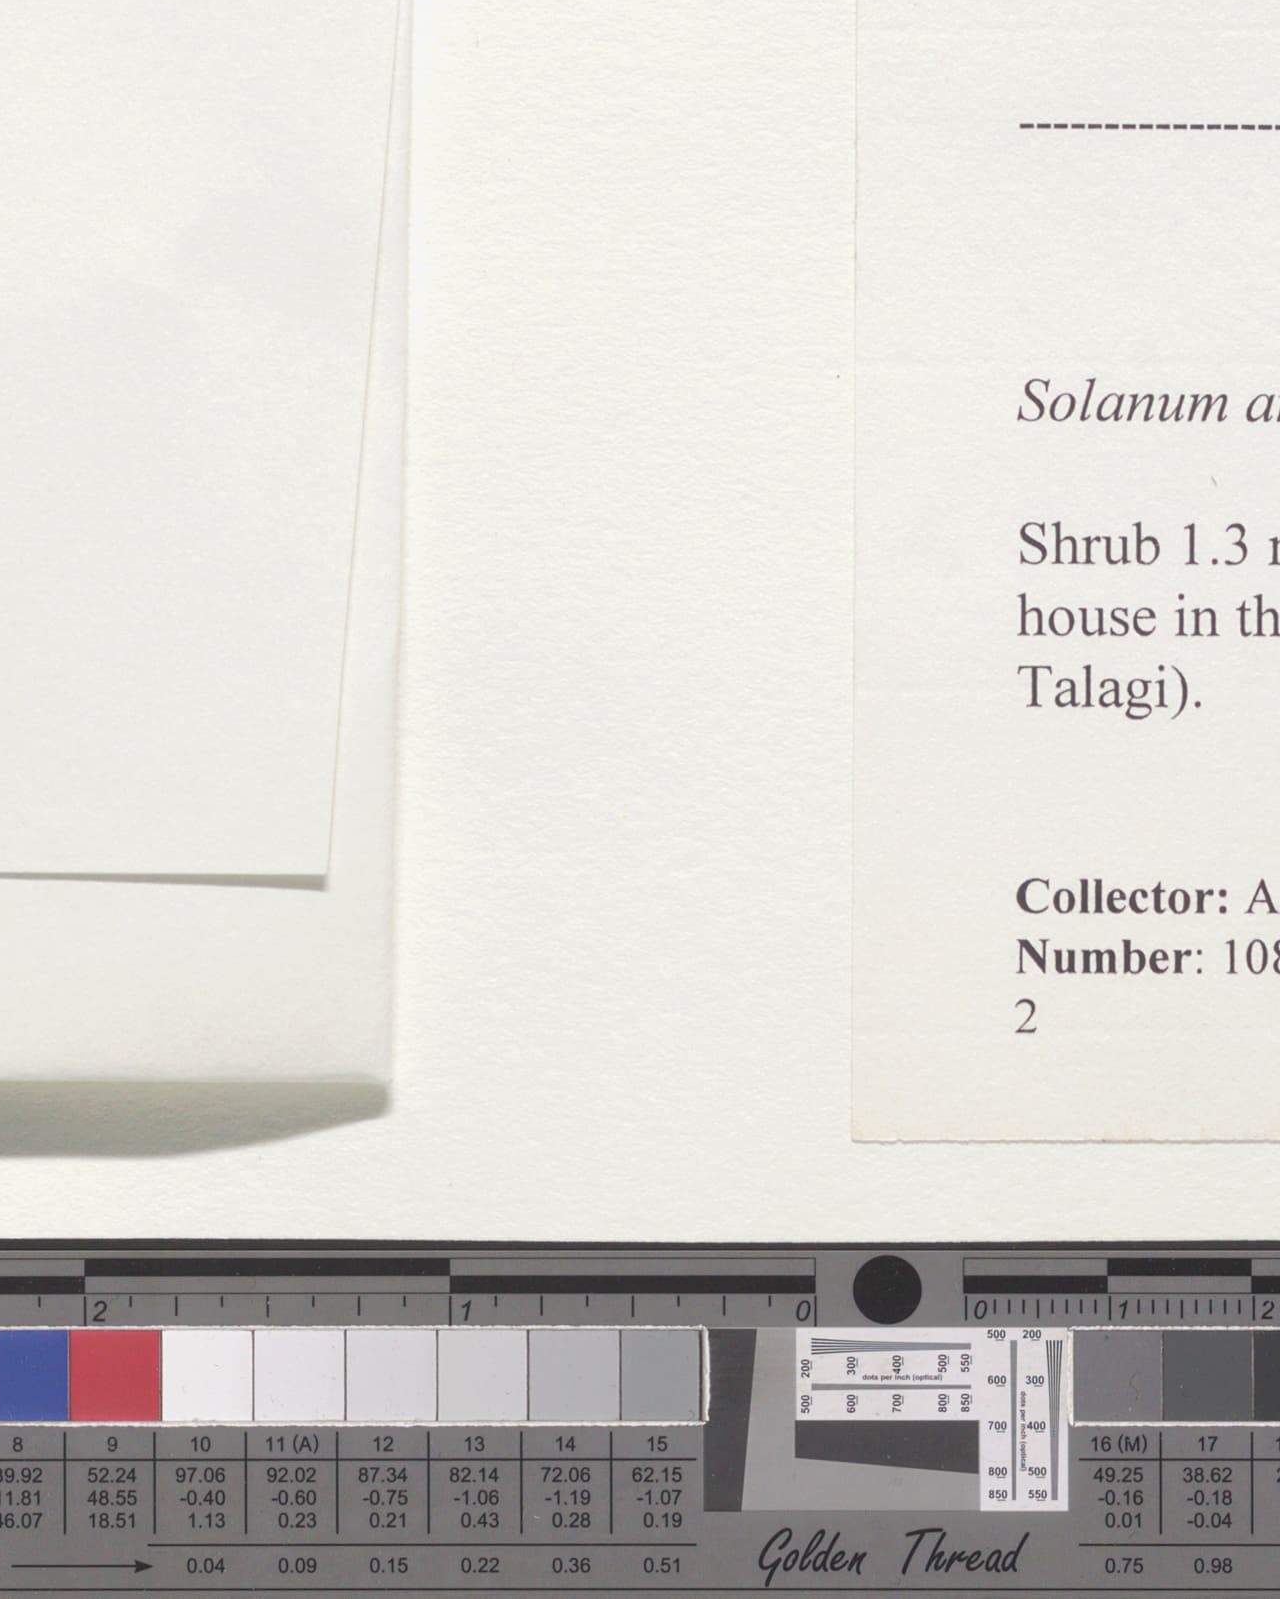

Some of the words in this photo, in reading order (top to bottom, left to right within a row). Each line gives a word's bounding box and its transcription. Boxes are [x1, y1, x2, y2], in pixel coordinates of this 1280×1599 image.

[1016, 377, 1228, 423] Solanum
[1019, 520, 1161, 566] Shrub
[1183, 522, 1248, 566] 1.3
[1017, 592, 1157, 637] house
[1175, 593, 1220, 637] in
[1017, 664, 1202, 721] Talagi).
[1015, 877, 1227, 915] Collector:
[1016, 938, 1203, 975] Number:
[1015, 998, 1037, 1034] 2
[92, 1299, 108, 1323] 2
[461, 1299, 472, 1322] 1
[795, 1299, 812, 1322] 0
[973, 1299, 988, 1320] 0
[1118, 1299, 1129, 1320] 1
[1261, 1300, 1275, 1320] 2
[881, 1374, 893, 1383] per
[894, 1373, 912, 1381] inch
[912, 1373, 943, 1383] (optical)
[12, 1436, 24, 1453] 8
[107, 1436, 118, 1453] 9
[190, 1435, 212, 1453] 10
[265, 1436, 284, 1453] 11
[292, 1433, 320, 1455] (A)
[372, 1435, 394, 1453] 12
[464, 1435, 486, 1453] 13
[555, 1435, 577, 1452] 14
[647, 1435, 668, 1453] 15
[1090, 1435, 1112, 1453] 16
[1117, 1433, 1148, 1454] (M)
[1198, 1435, 1219, 1453] 17
[87, 1466, 137, 1484] 52.24
[175, 1466, 226, 1484] 97.06
[266, 1466, 317, 1484] 92.02
[186, 1557, 226, 1575] 0.04
[277, 1557, 318, 1574] 0.09
[369, 1556, 409, 1574] 0.15
[460, 1557, 500, 1574] 0.22
[551, 1557, 592, 1574] 0.36
[643, 1556, 680, 1574] 0.51
[758, 1527, 868, 1587] Golden
[901, 1527, 1030, 1576] Thread
[1104, 1557, 1144, 1574] 0.75
[1193, 1557, 1233, 1575] 0.98
